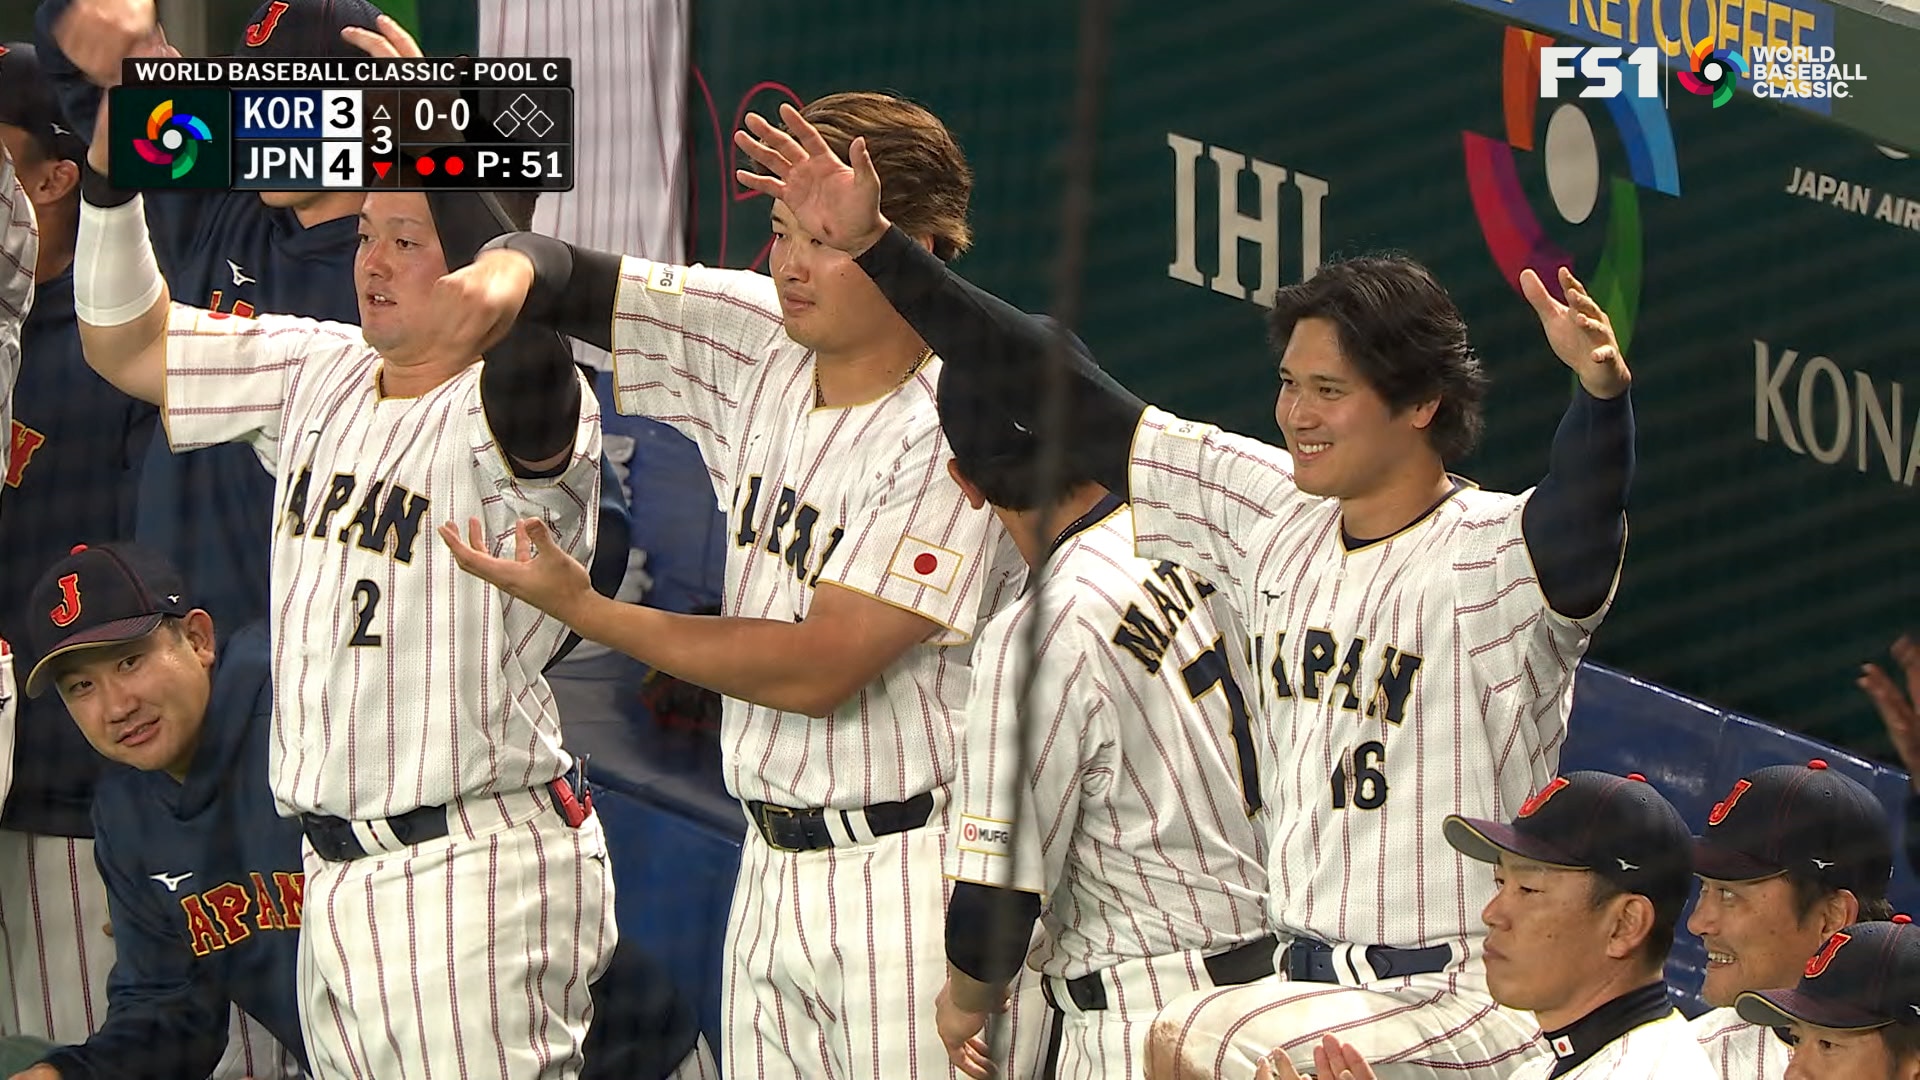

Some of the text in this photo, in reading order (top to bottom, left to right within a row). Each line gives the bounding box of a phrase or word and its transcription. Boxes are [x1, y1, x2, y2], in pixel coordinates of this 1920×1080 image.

[245, 0, 289, 47] J
[1785, 166, 1871, 216] JAPAN
[1167, 132, 1329, 309] IHI
[276, 465, 431, 568] APAN
[50, 573, 81, 626] J
[348, 579, 382, 648] 2
[1330, 740, 1390, 810] 16
[1518, 777, 1570, 818] J
[1708, 778, 1752, 826] J
[1804, 933, 1851, 978] J
